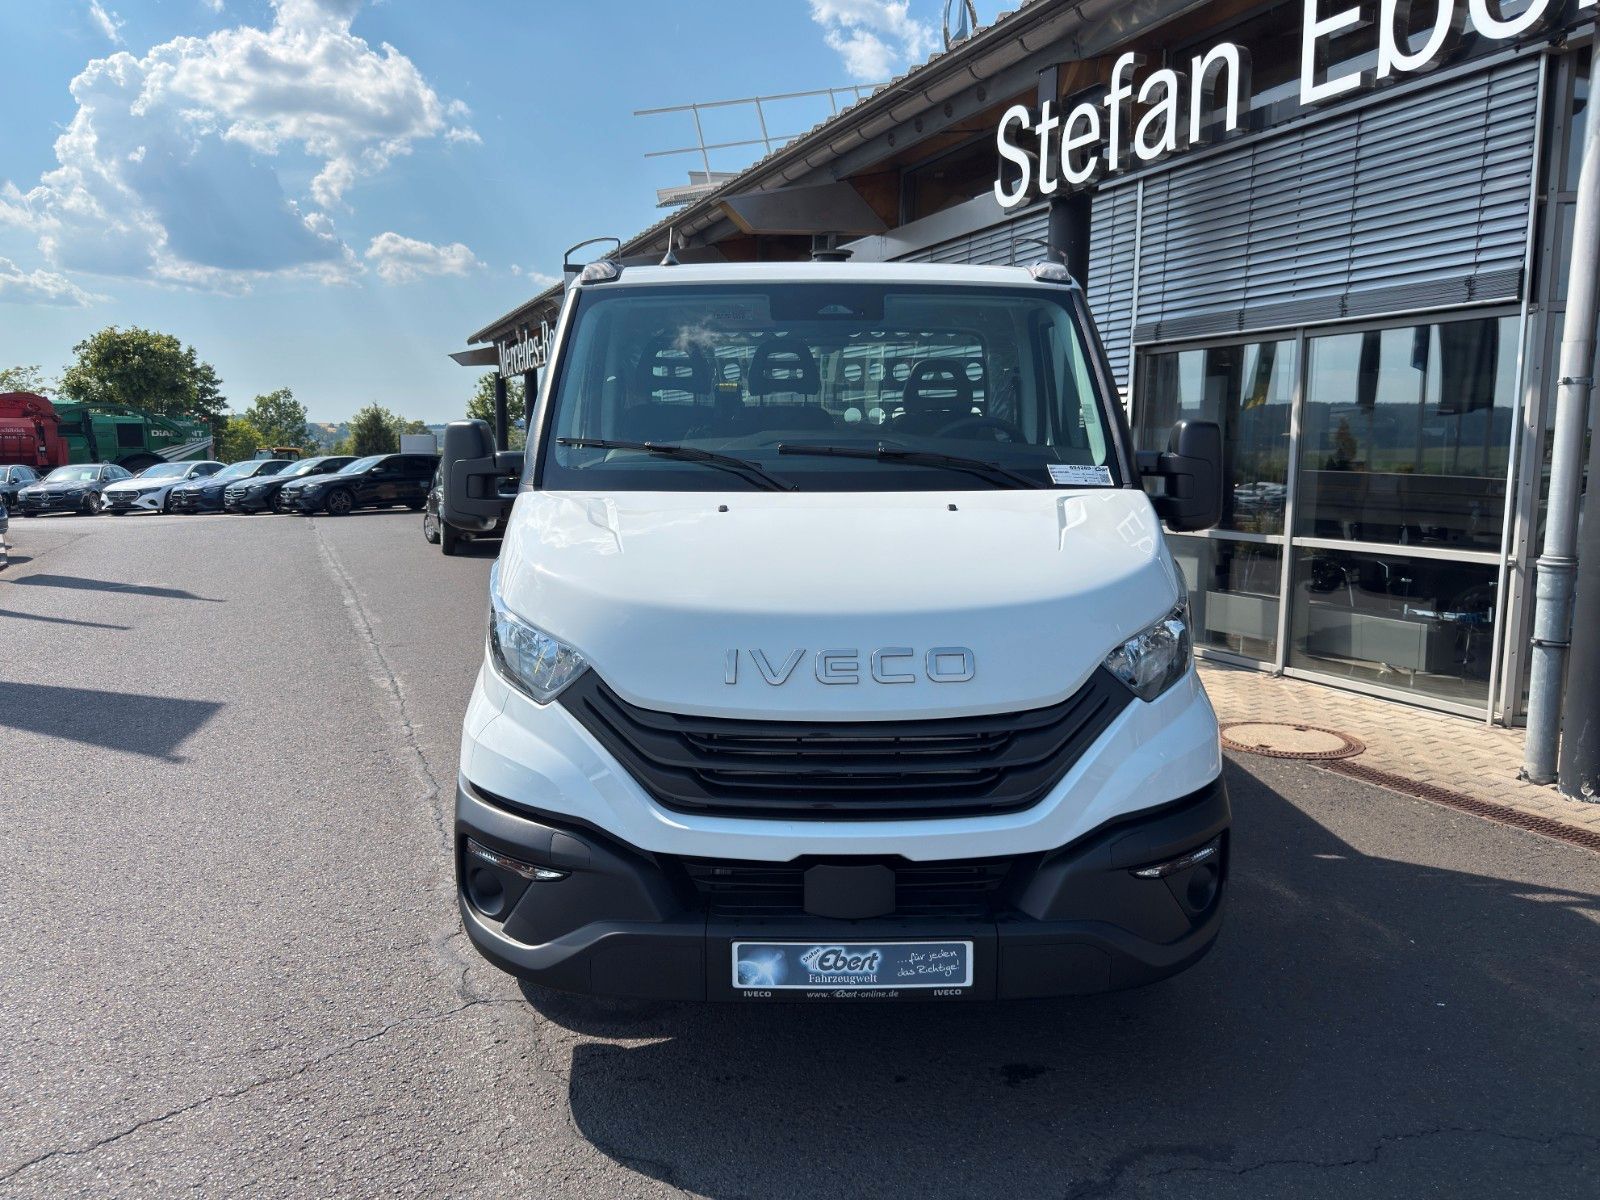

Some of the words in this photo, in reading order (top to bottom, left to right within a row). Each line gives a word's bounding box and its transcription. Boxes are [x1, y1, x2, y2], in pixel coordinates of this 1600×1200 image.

[994, 42, 1240, 208] Stefan
[724, 646, 975, 686] IVECO
[818, 948, 879, 971] Ebert
[929, 949, 958, 961] jeden
[809, 974, 878, 985] Fahrzeugwelt
[897, 967, 915, 977] das
